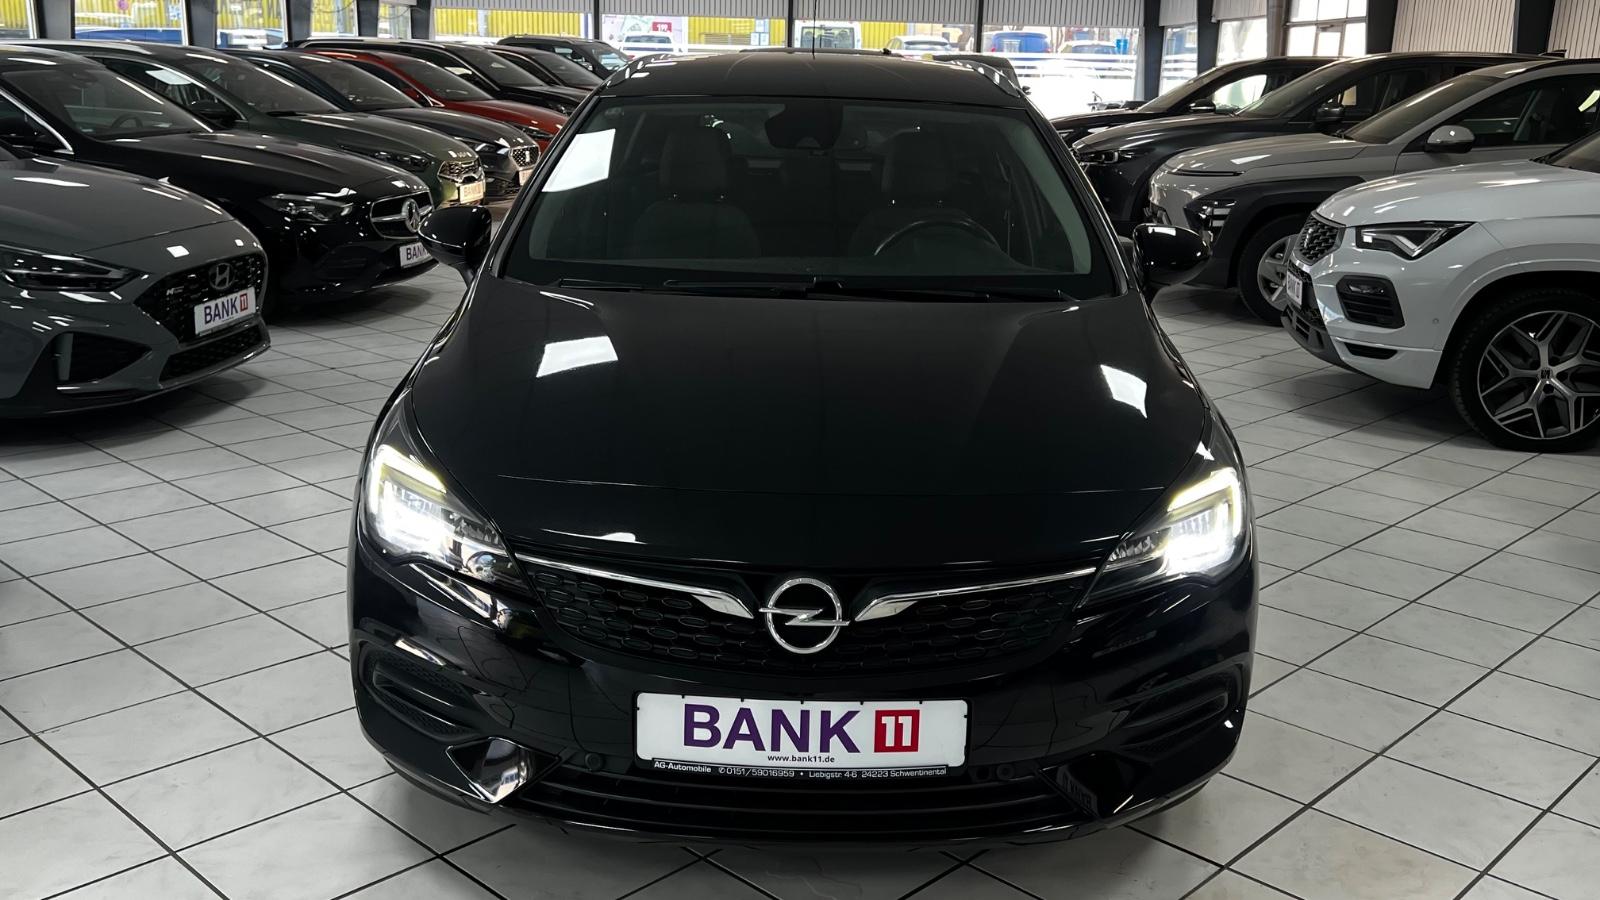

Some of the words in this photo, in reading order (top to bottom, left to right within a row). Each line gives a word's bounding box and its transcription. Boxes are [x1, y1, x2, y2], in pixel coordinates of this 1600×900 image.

[204, 296, 238, 325] BANK
[684, 703, 861, 753] BANK
[880, 714, 914, 748] 11
[653, 761, 712, 773] AG-Automobile
[861, 769, 888, 778] 24223
[889, 768, 947, 778] Schwentinental
[767, 754, 835, 763] www.bank11.de
